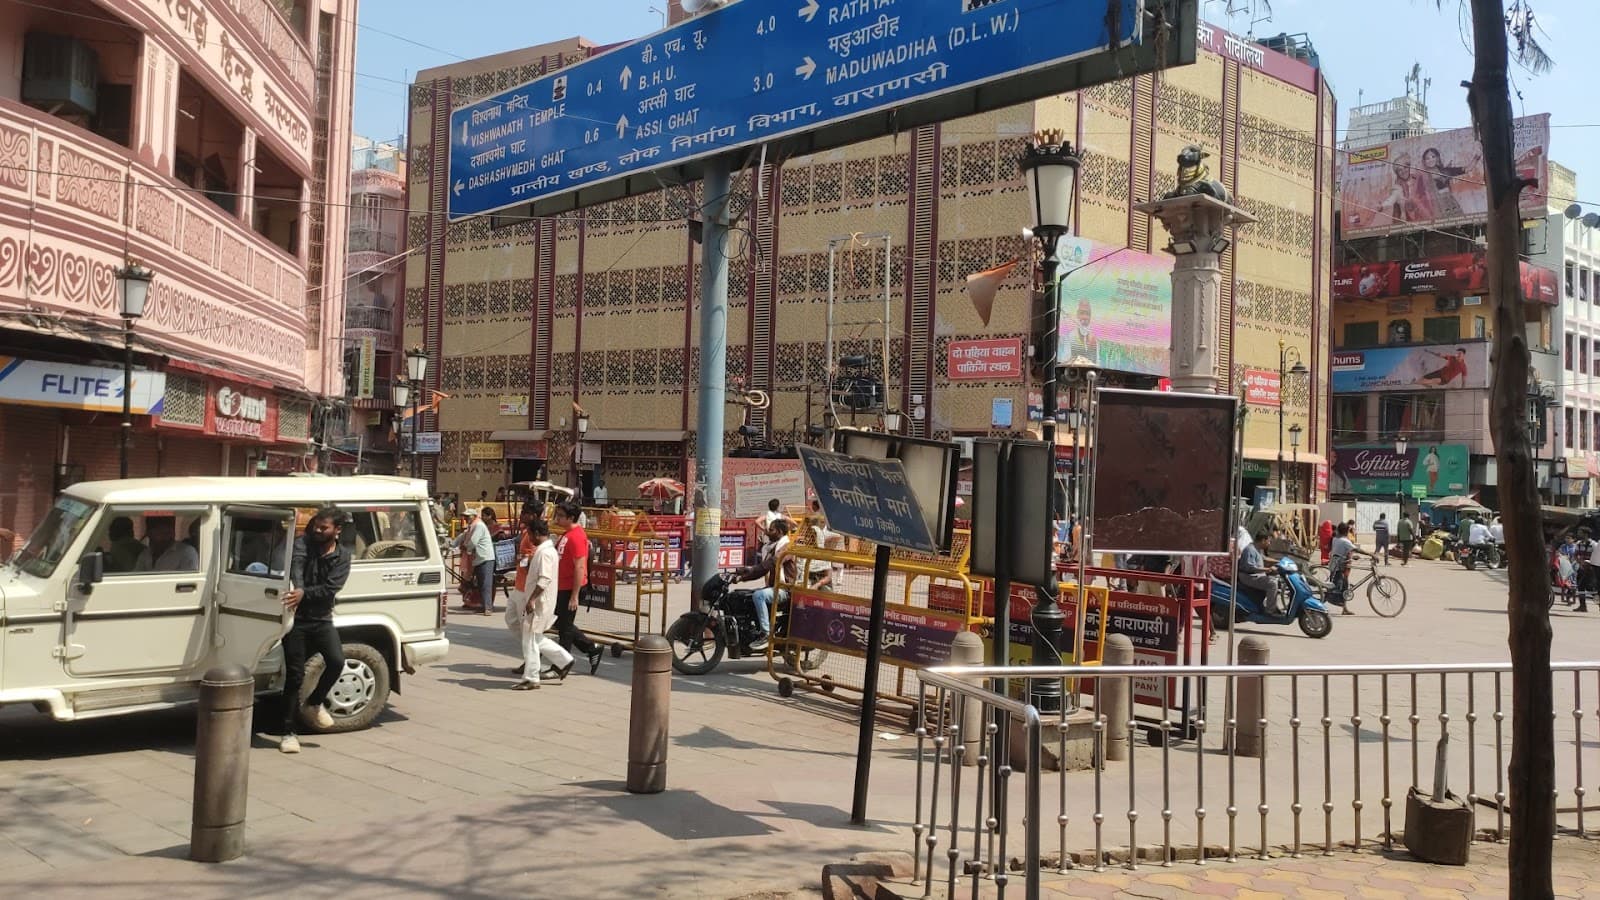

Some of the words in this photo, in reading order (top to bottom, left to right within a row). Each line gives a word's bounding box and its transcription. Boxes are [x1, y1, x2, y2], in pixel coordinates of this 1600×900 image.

[757, 16, 776, 35] 4.0
[828, 14, 900, 57] मडुआडीह
[826, 40, 937, 85] MADUWADIHA
[948, 8, 1019, 50] (D.L.W.)
[586, 79, 603, 97] 0.4
[753, 73, 774, 92] 3.0
[638, 88, 668, 114] अस्सी
[674, 83, 697, 102] घाट
[472, 104, 503, 127] विश्वनाथ
[507, 94, 530, 113] मन्दिर
[471, 119, 524, 148] VISHWANATH
[529, 103, 567, 127] TEMPLE
[511, 174, 561, 196] प्रान्तीय
[568, 160, 612, 179] खण्ड,
[618, 144, 663, 166] लोक
[671, 124, 737, 151] निर्माण
[747, 102, 822, 132] विभाग,
[832, 62, 950, 107] वाराणसी
[636, 119, 663, 140] ASSI
[668, 108, 700, 130] GHAT
[584, 128, 600, 145] 0.6
[470, 144, 506, 169] दशाश्वमेध
[511, 139, 527, 155] घाट
[469, 159, 537, 190] DASHASHVMEDH
[541, 149, 566, 168] GHAT
[1334, 278, 1353, 286] TLINE
[1403, 269, 1447, 280] FRONTLINE
[951, 346, 963, 358] दो
[965, 345, 991, 358] पहिया
[992, 346, 1017, 357] वाहन
[1333, 356, 1361, 365] hums
[42, 374, 110, 397] FLITE
[1350, 449, 1410, 474] Softline
[884, 496, 913, 519] मार्ग
[1135, 681, 1159, 692] PANY
